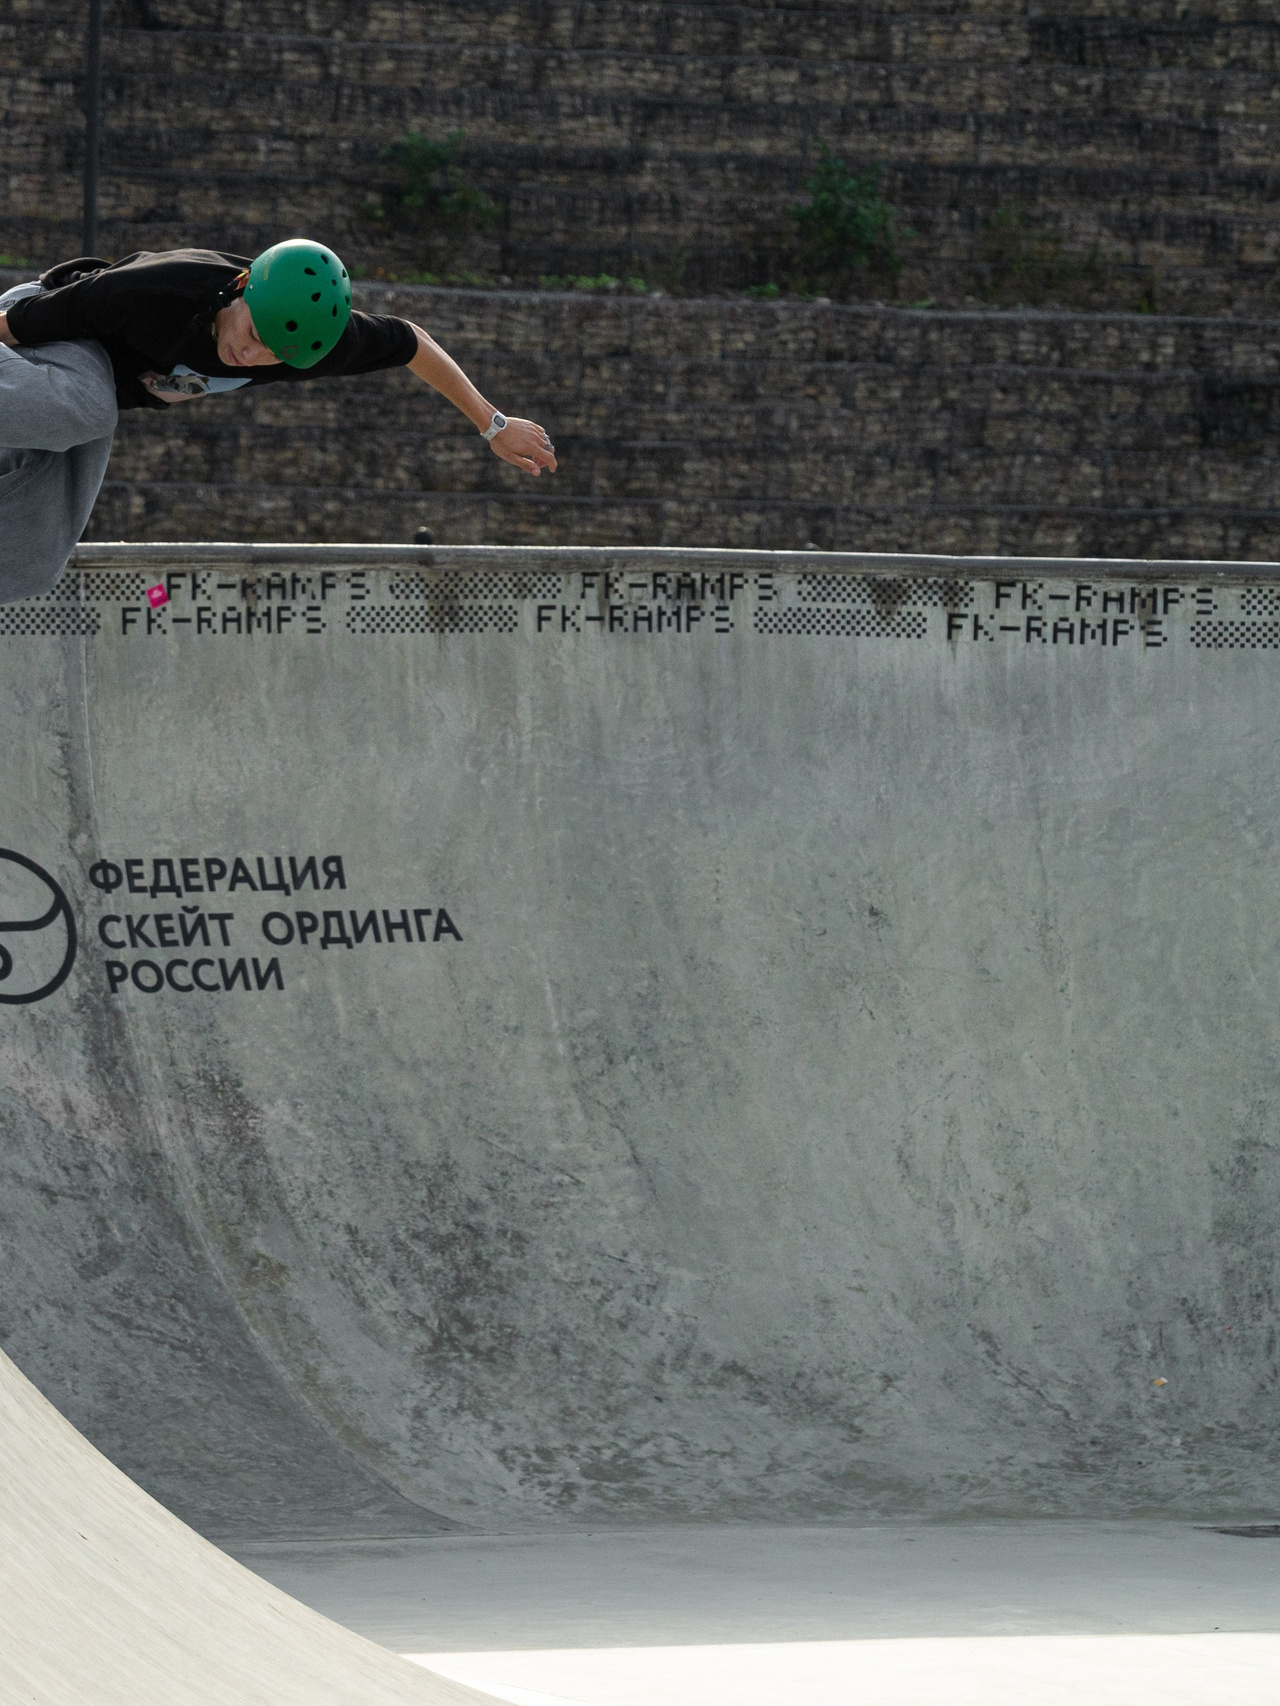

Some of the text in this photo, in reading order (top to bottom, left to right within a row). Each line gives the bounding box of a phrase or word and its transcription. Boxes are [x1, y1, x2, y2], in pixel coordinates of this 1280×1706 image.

[167, 572, 371, 601] FK-RAMPS
[580, 571, 778, 601] FK-RAMPS
[995, 581, 1218, 615] FK-RAMPS
[122, 606, 326, 635] FK-RAMPS
[537, 605, 735, 633] FK-RAMPS
[947, 613, 1168, 648] FK-RAMPS
[88, 855, 347, 898] ФЕДЕРАЦИЯ
[97, 905, 464, 950] СКЕЙТ ОРДИНГА
[104, 956, 286, 994] РОССИИ
